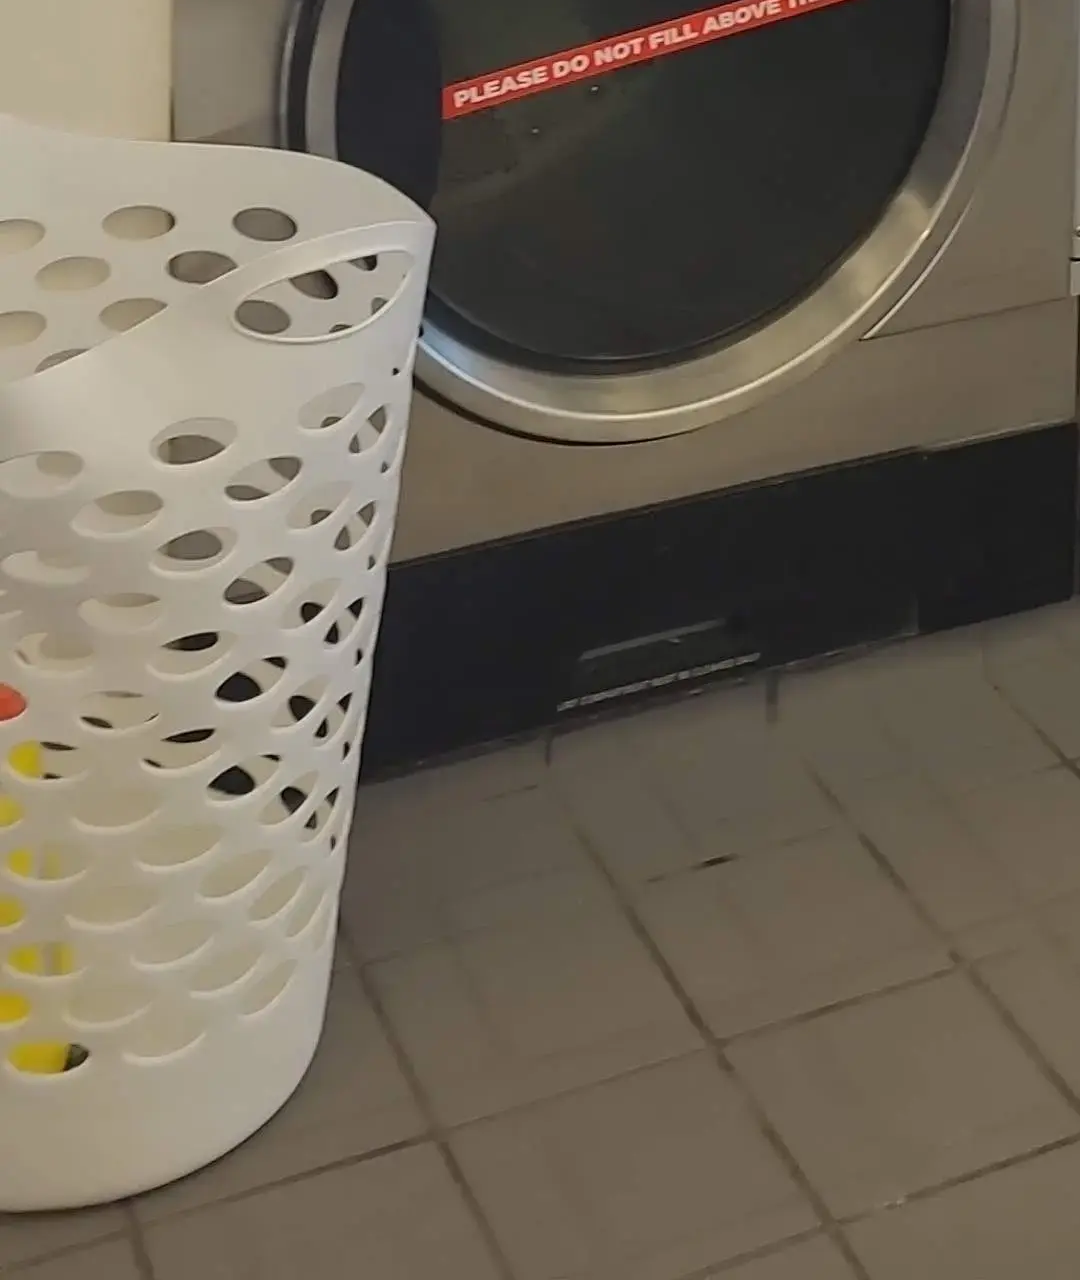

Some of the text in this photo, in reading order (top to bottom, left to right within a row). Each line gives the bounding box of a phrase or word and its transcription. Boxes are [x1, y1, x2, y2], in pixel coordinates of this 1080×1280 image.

[453, 66, 549, 108] PLEASE
[552, 54, 590, 79] DO
[593, 37, 644, 66] NOT
[649, 22, 699, 50] FILL
